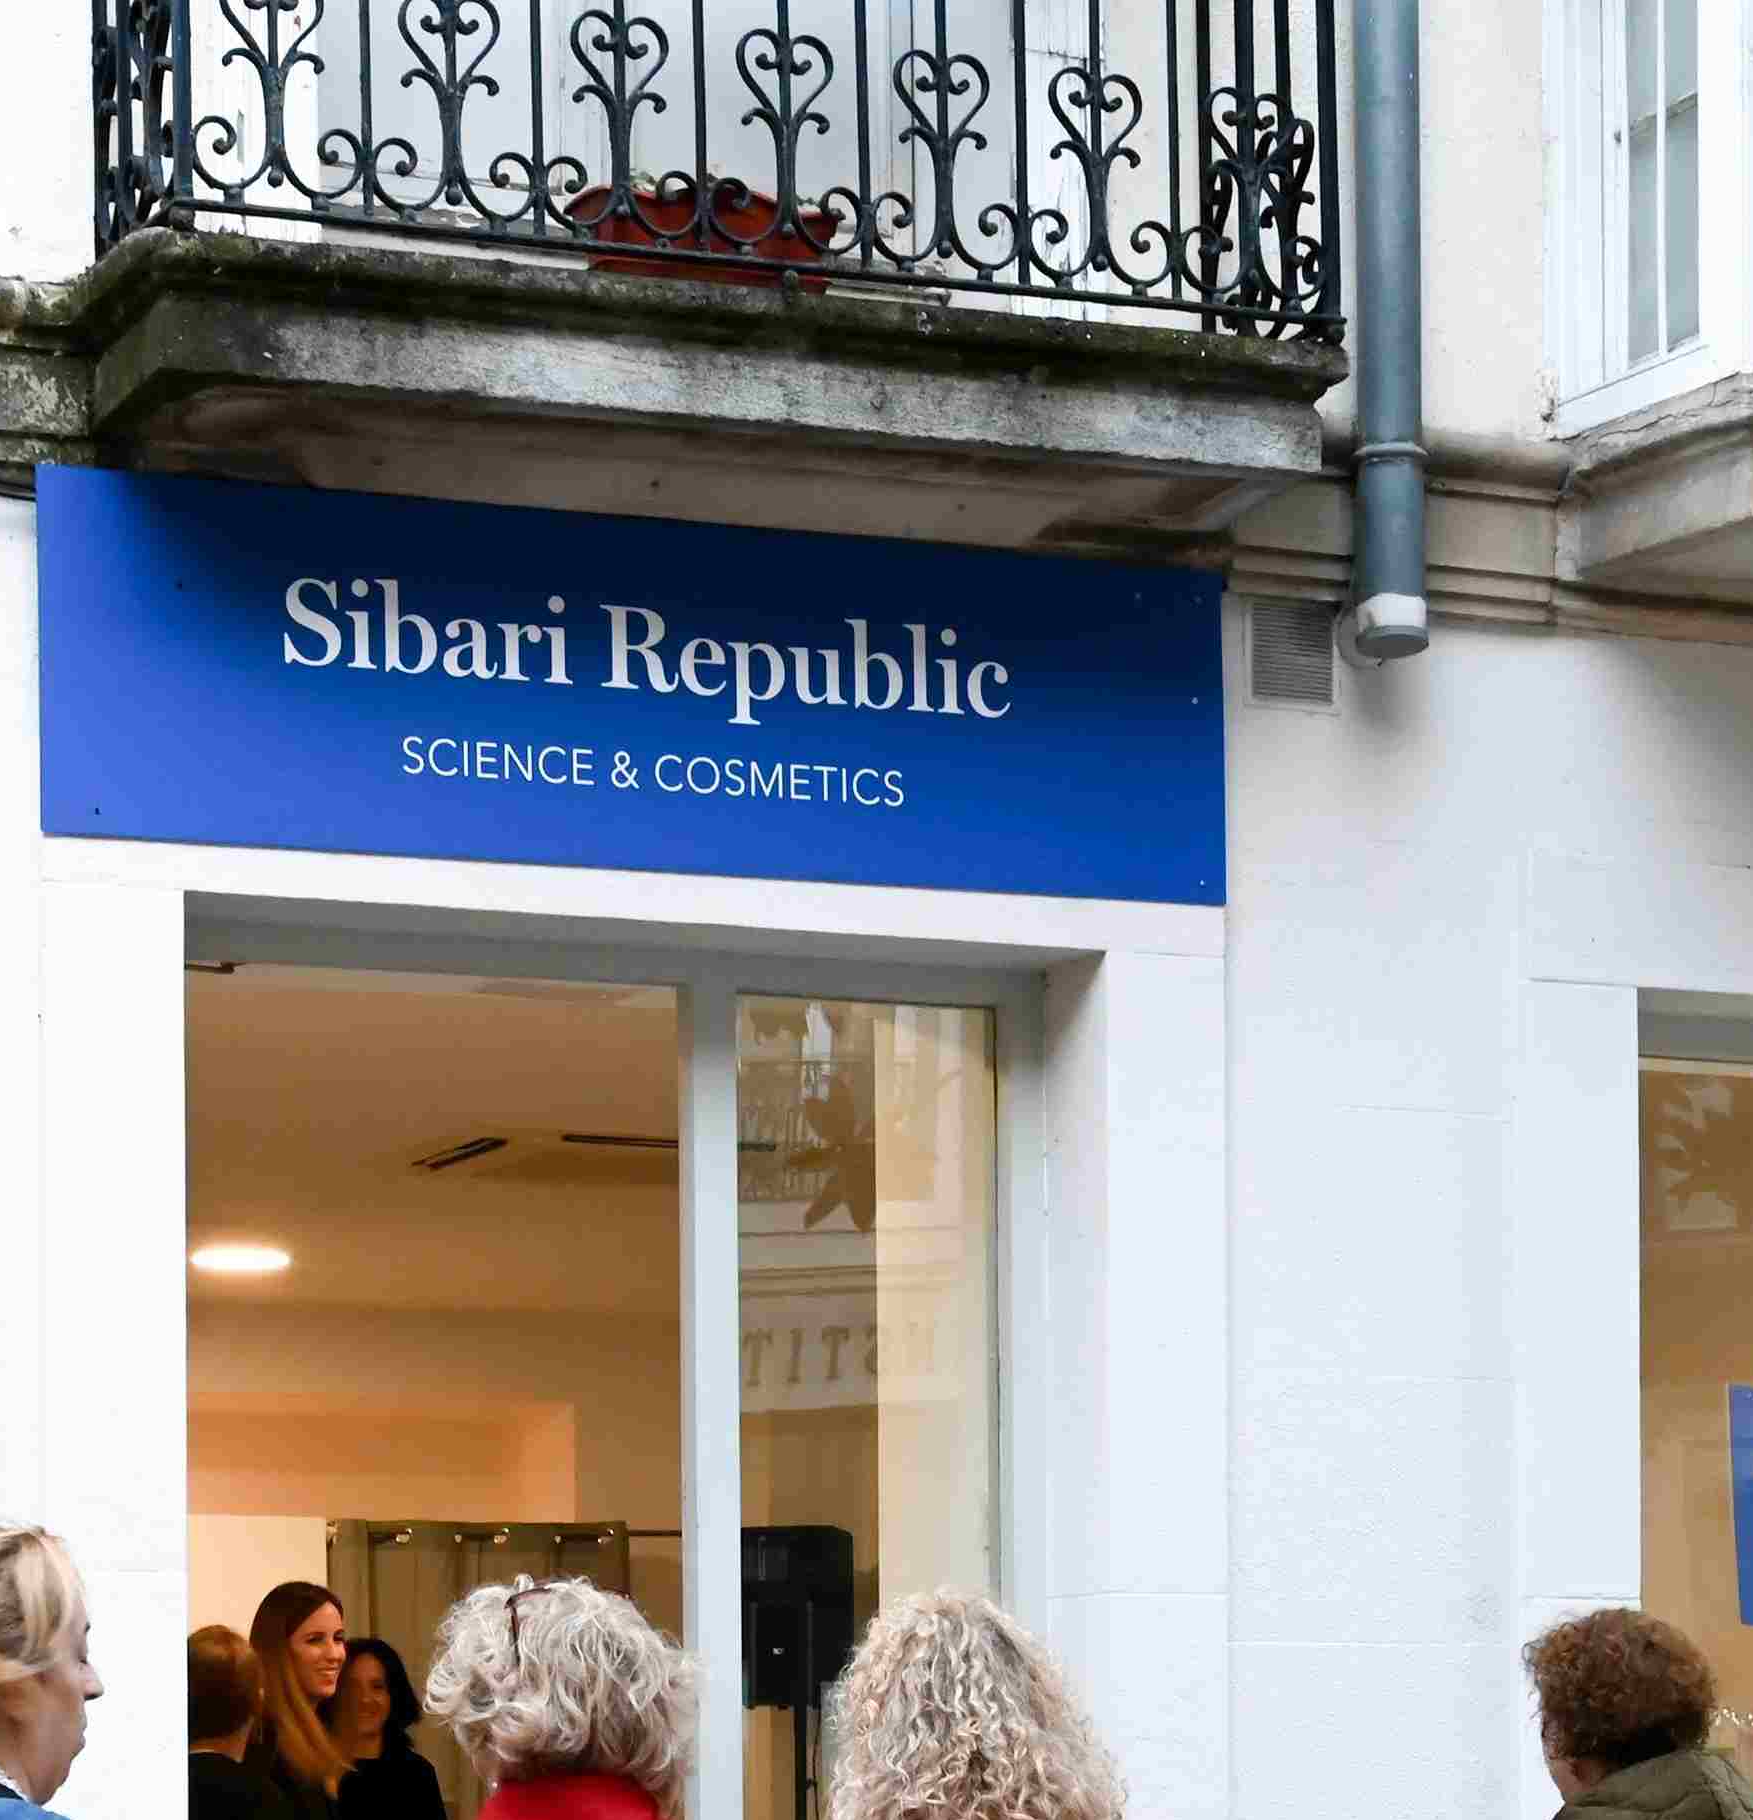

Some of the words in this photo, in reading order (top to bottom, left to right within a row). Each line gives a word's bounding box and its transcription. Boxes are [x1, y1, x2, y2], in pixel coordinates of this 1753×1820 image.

[283, 578, 574, 685] Sibari
[600, 604, 1011, 726] Republic
[402, 736, 595, 785] SCIENCE
[611, 751, 639, 789] &
[655, 754, 904, 807] COSMETICS
